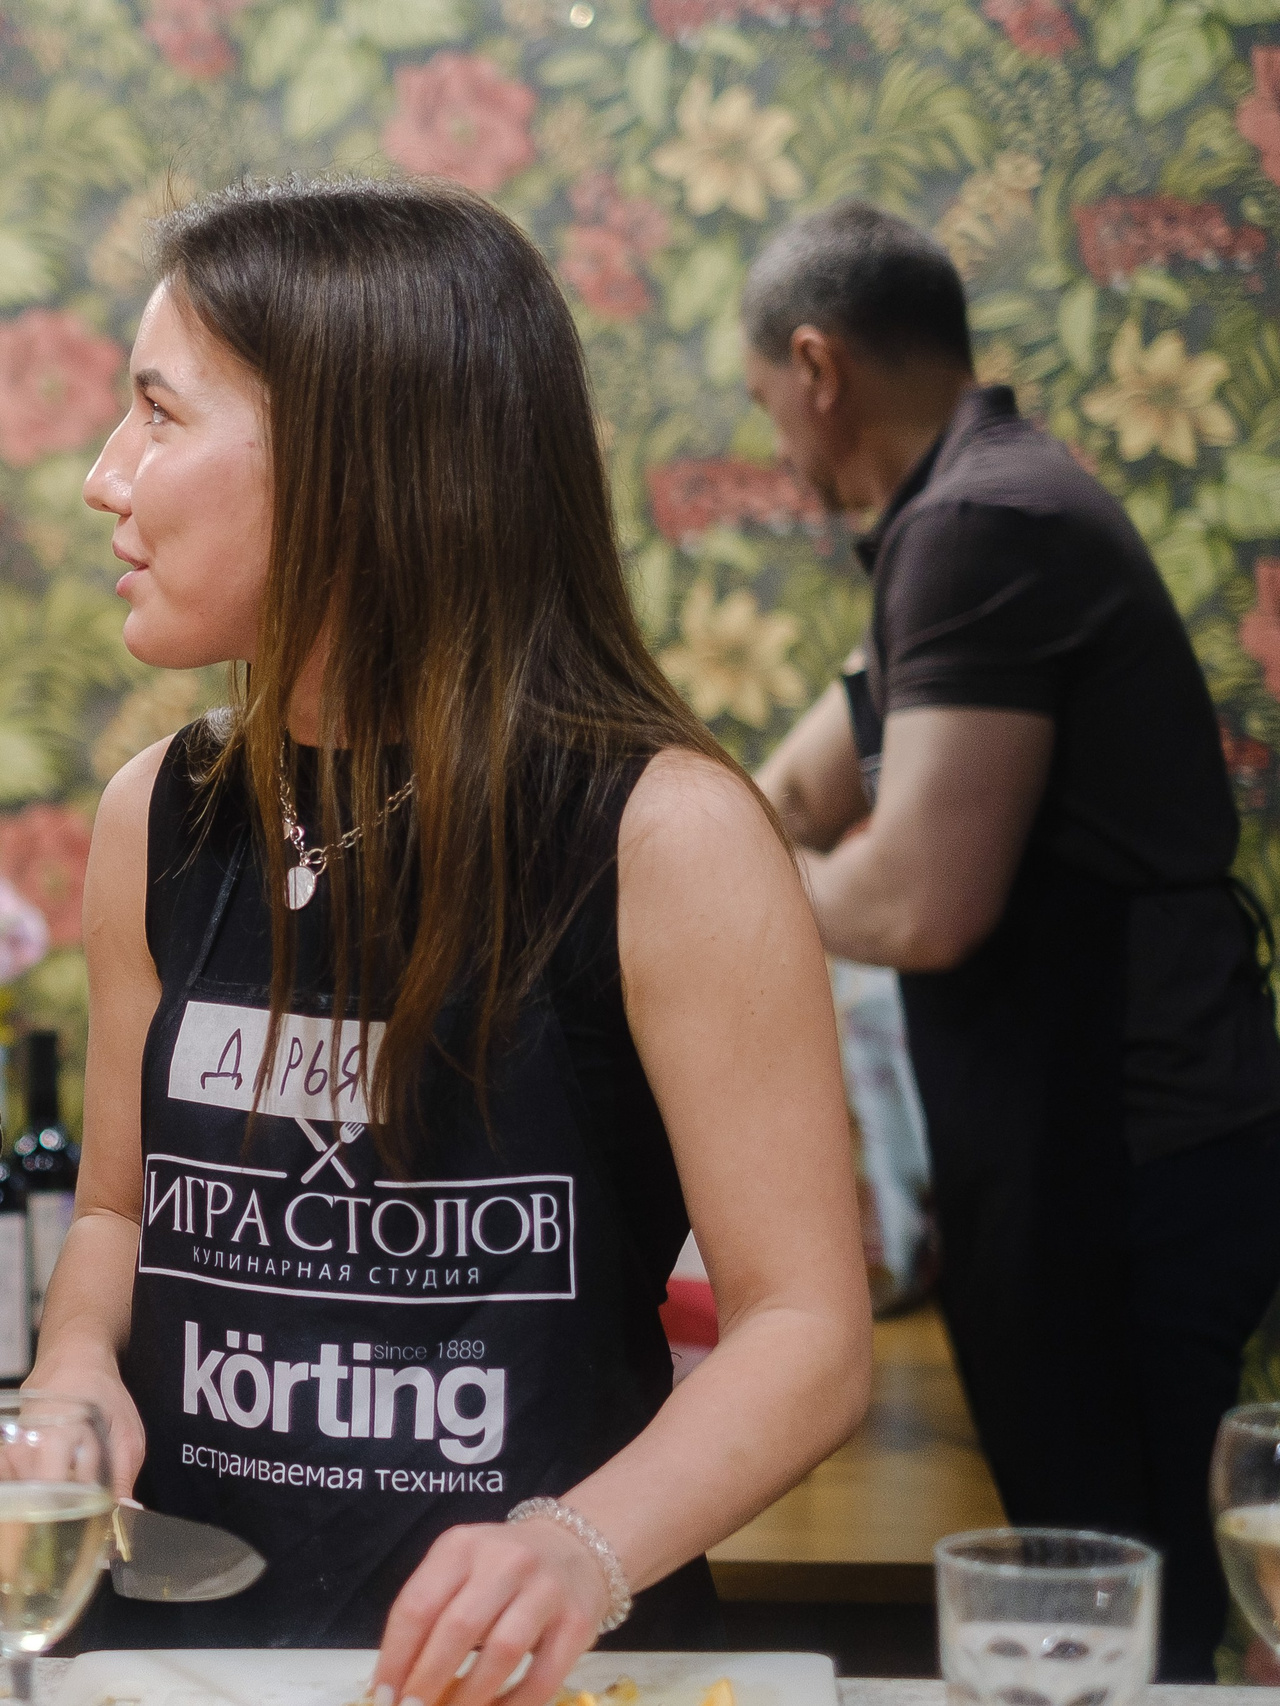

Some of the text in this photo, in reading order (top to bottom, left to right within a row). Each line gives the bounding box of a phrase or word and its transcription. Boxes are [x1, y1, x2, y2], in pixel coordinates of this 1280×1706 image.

[147, 1170, 561, 1257] ИГРА СТОЛОВ
[193, 1245, 481, 1289] КУЛИНАРНАЯ СТУДИЯ
[374, 1340, 486, 1360] since 1889
[183, 1320, 506, 1464] körting
[182, 1442, 504, 1493] встраиваемая техника
